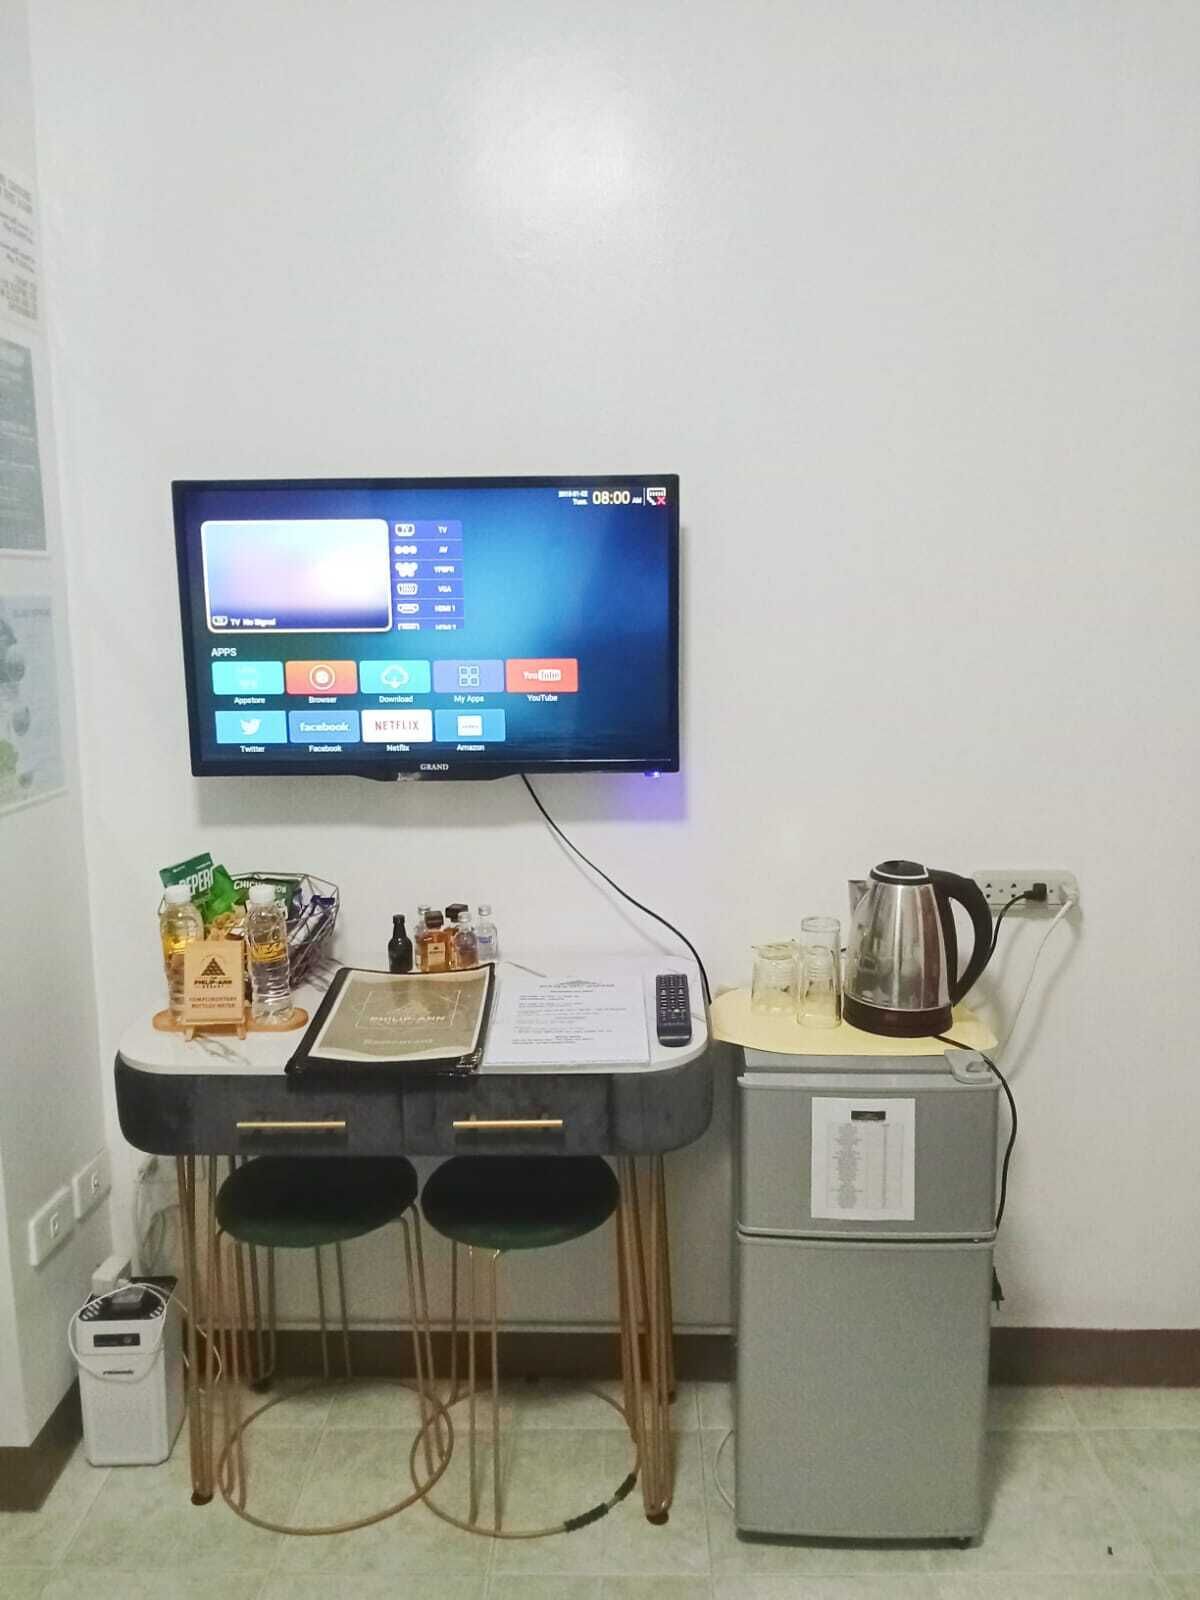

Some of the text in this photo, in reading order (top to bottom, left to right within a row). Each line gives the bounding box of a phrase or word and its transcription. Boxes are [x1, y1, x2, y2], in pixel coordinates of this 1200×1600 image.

[592, 490, 630, 505] 08:00
[437, 526, 448, 534] TV
[211, 648, 237, 657] APPS
[233, 697, 266, 705] Appstore
[308, 696, 337, 705] Browser
[378, 695, 414, 704] Download
[453, 695, 485, 705] My Apps
[527, 694, 558, 703] YouTube
[375, 720, 420, 731] NETFLIX
[240, 745, 265, 753] Twitter
[386, 744, 410, 752] Netflix
[456, 743, 486, 752] Amazon
[419, 763, 450, 771] GRAND
[179, 868, 214, 896] PER
